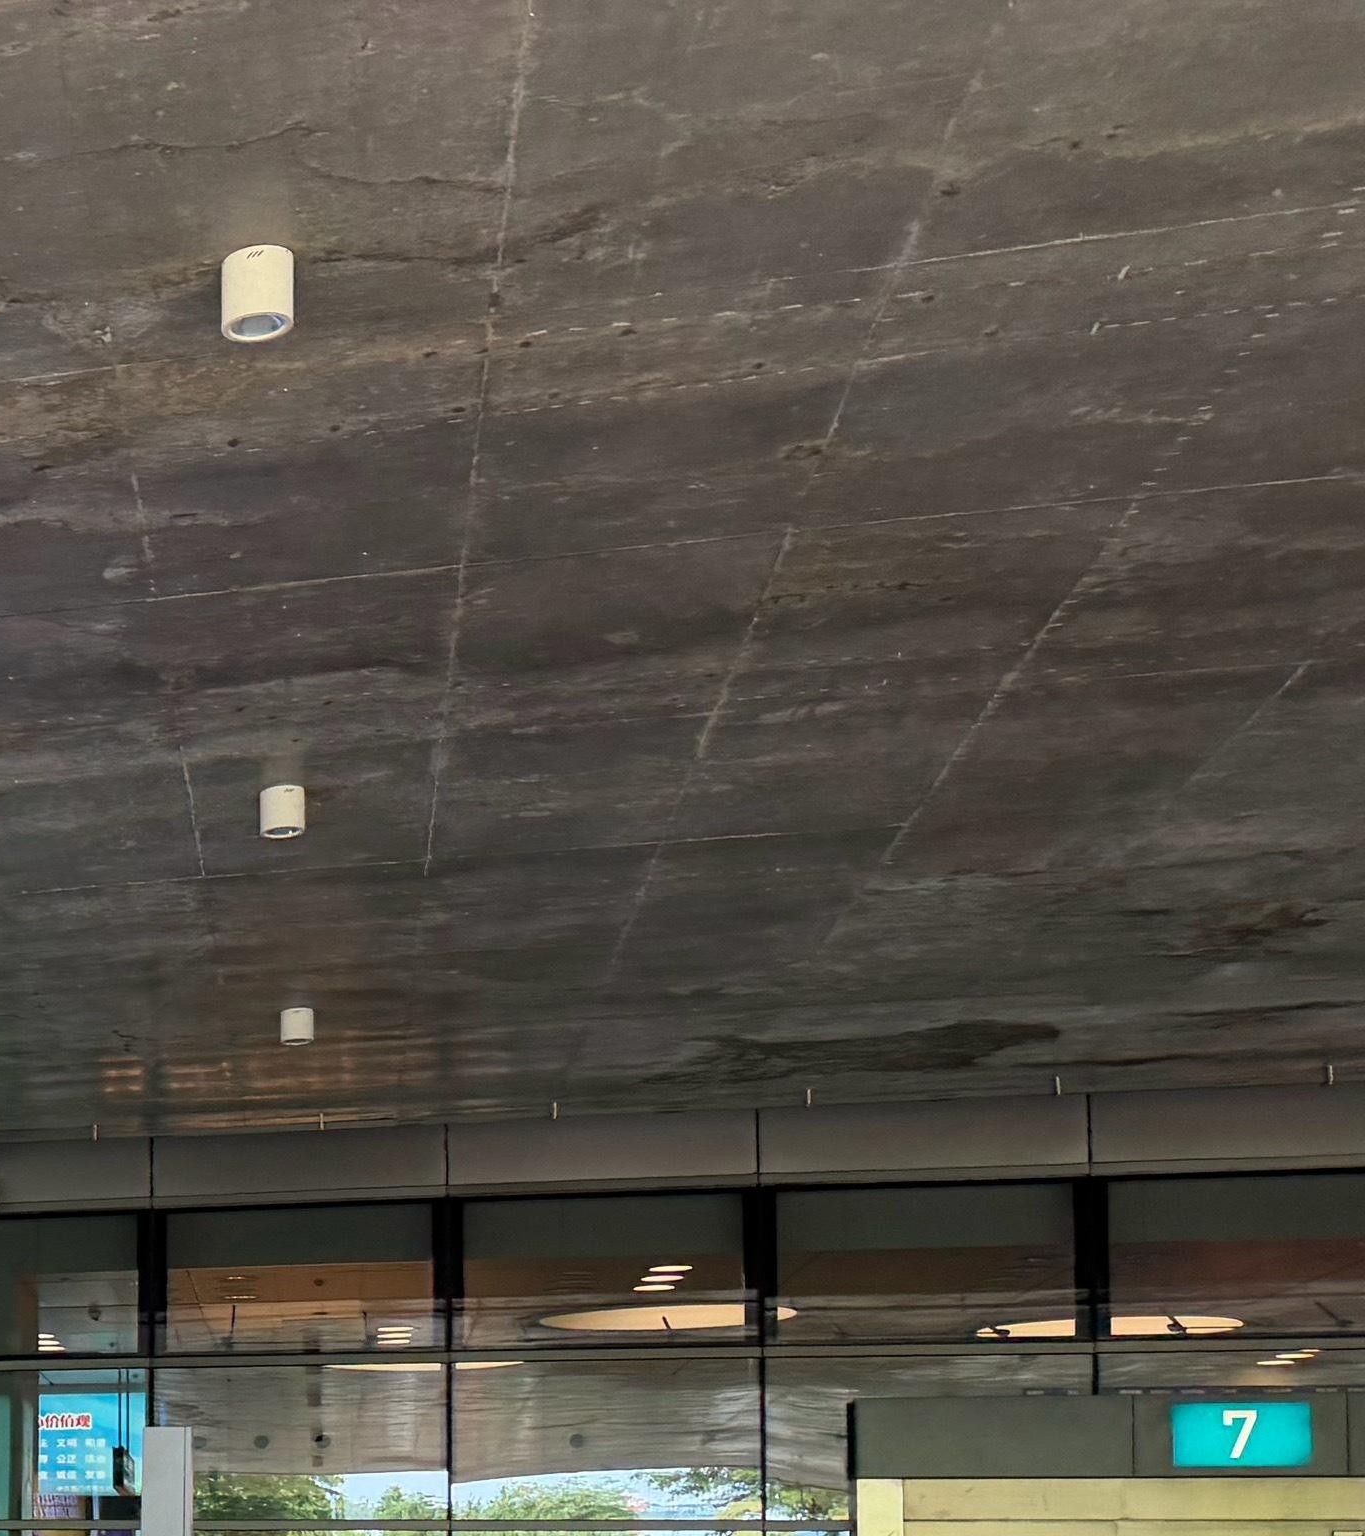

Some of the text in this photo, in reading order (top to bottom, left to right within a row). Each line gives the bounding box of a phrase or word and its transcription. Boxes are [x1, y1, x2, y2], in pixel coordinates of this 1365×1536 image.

[39, 1414, 91, 1429] 价值观
[1223, 1410, 1257, 1459] 7
